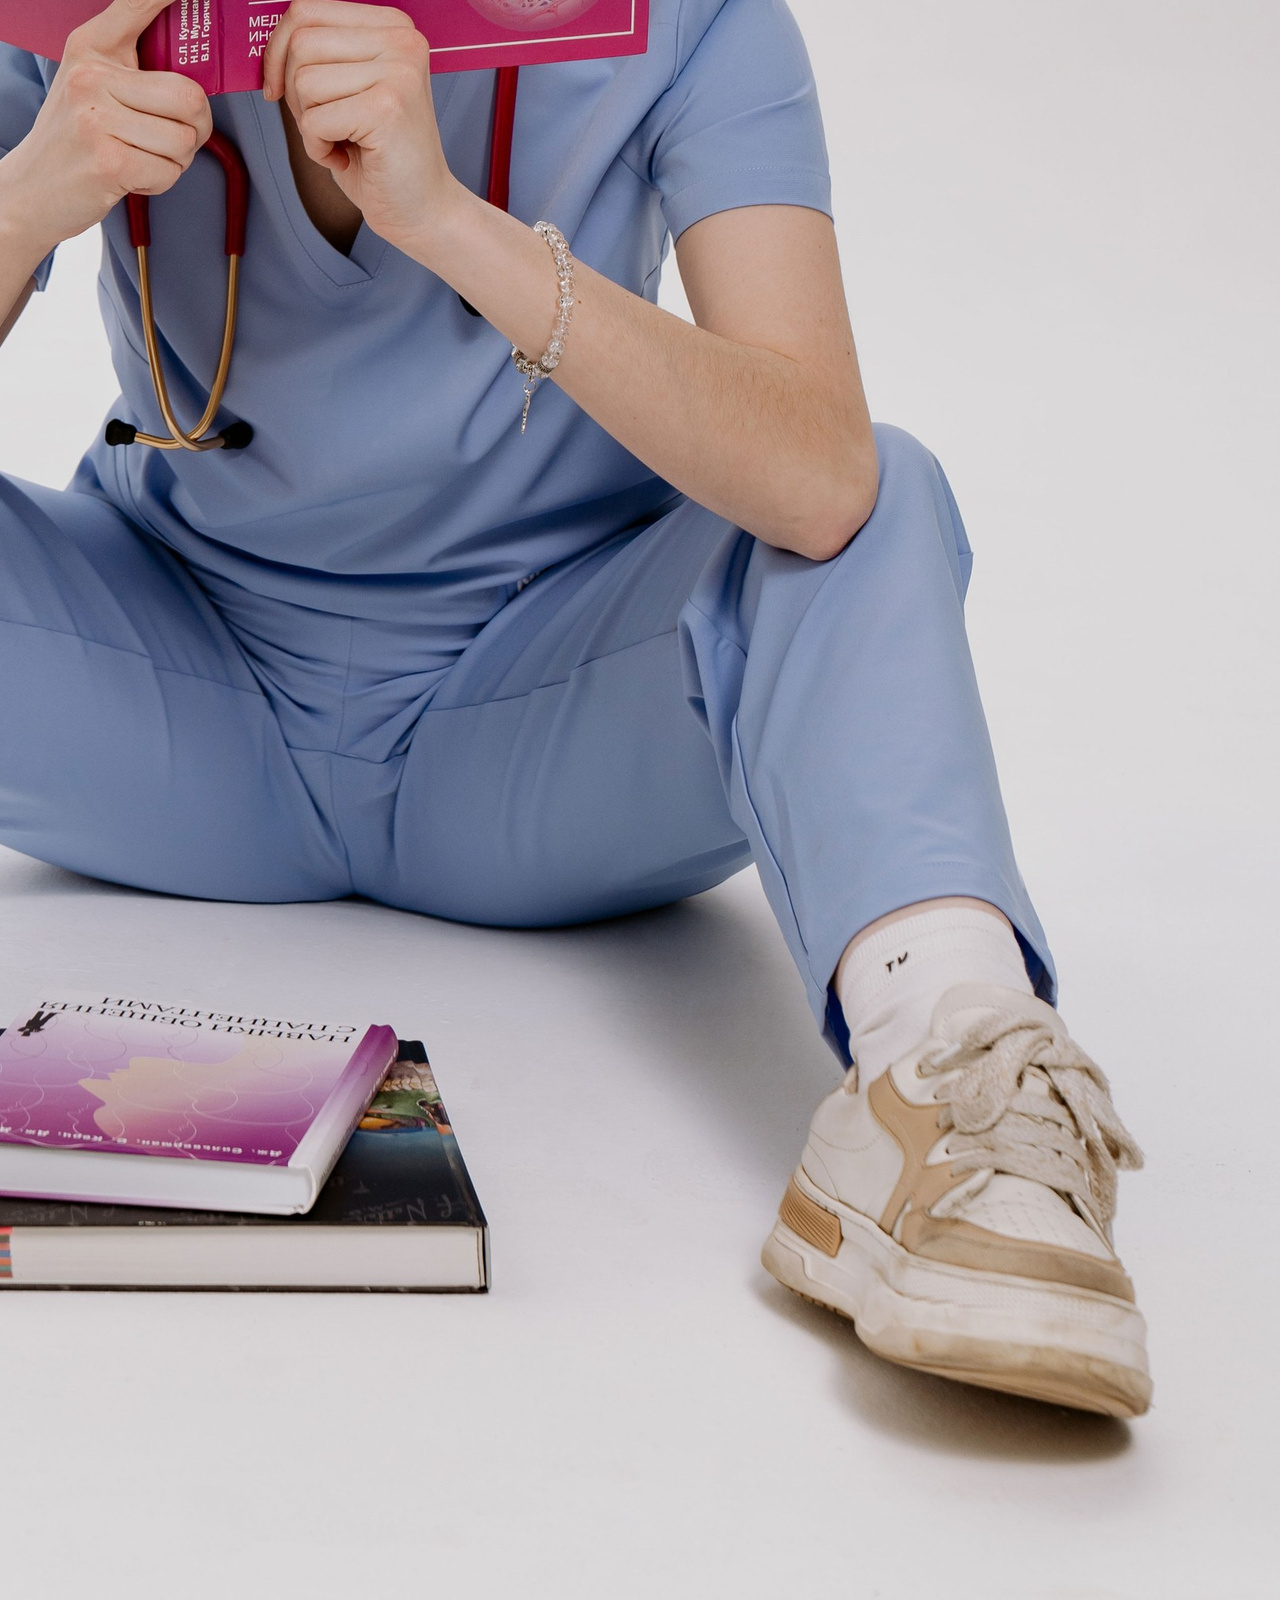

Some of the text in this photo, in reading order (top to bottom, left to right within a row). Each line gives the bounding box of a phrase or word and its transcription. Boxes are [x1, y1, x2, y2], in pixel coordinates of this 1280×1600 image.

[39, 1002, 351, 1043] НАВЫКИ ОБЩЕНИЯ
[101, 997, 357, 1033] С ПАЦИЕНТАМИ
